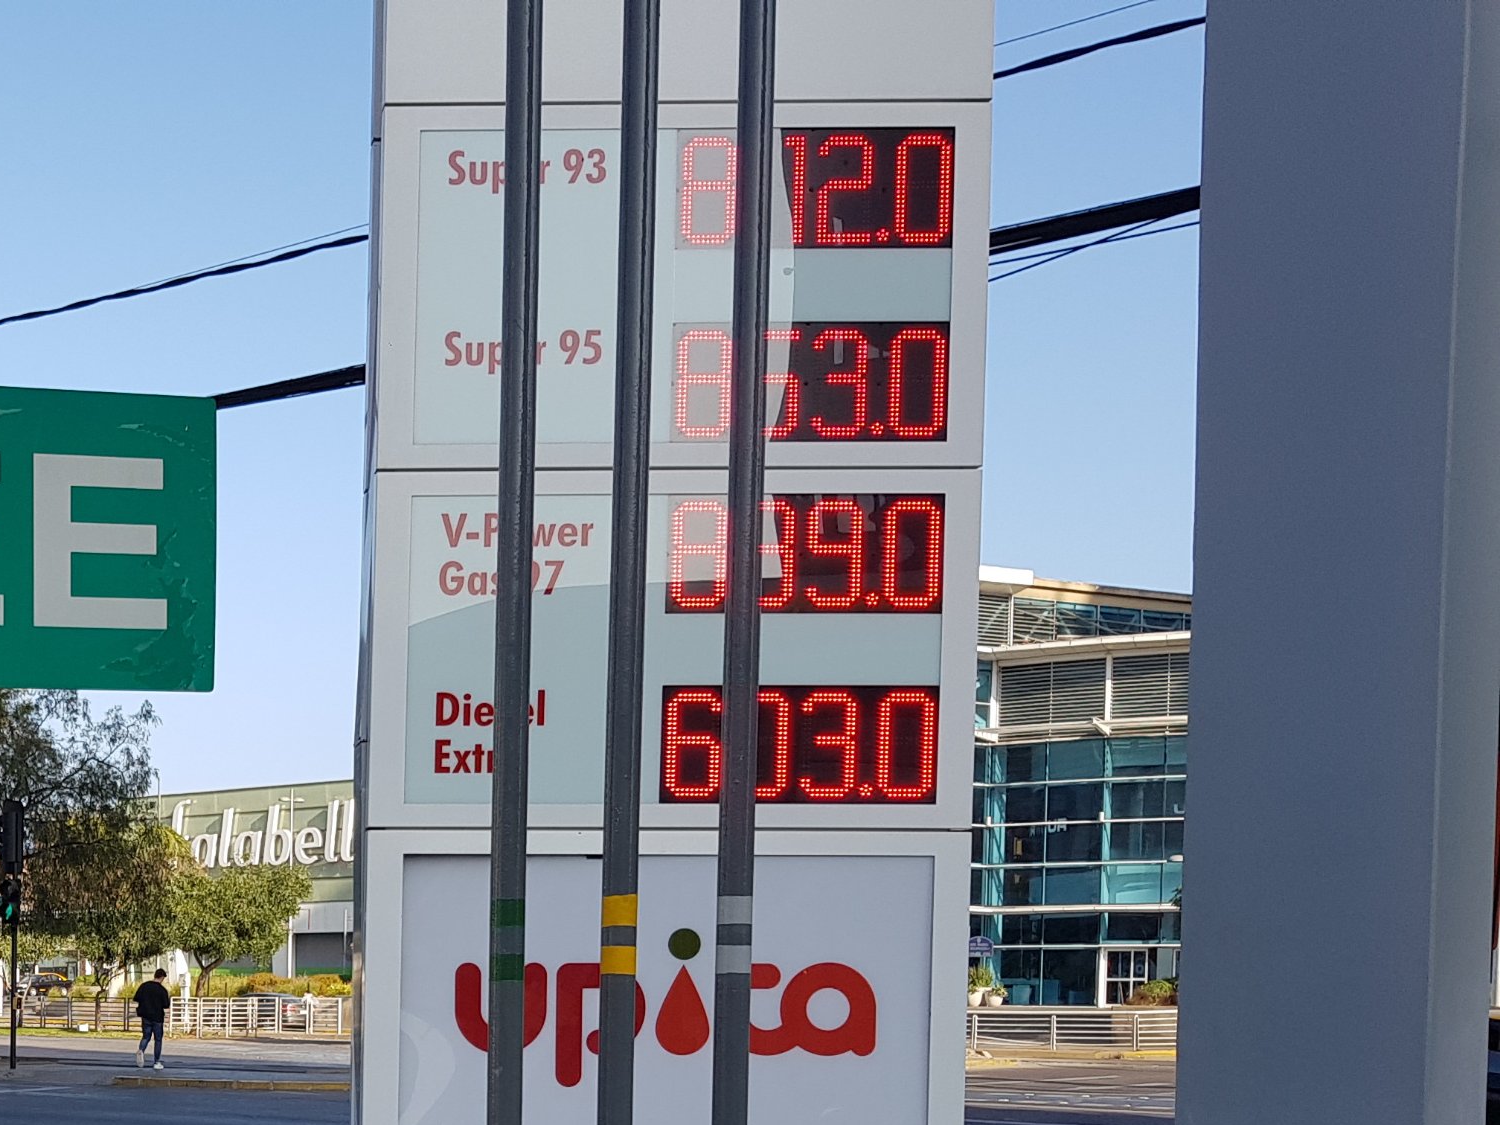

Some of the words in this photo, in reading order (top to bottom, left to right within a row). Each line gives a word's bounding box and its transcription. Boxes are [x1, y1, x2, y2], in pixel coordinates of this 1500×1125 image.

[448, 150, 551, 194] Supr
[563, 148, 607, 184] 93
[681, 133, 954, 243] 812.0
[444, 331, 547, 375] Supr
[559, 329, 602, 365] 95
[441, 513, 594, 548] V-Pwer
[435, 689, 546, 727] Diel
